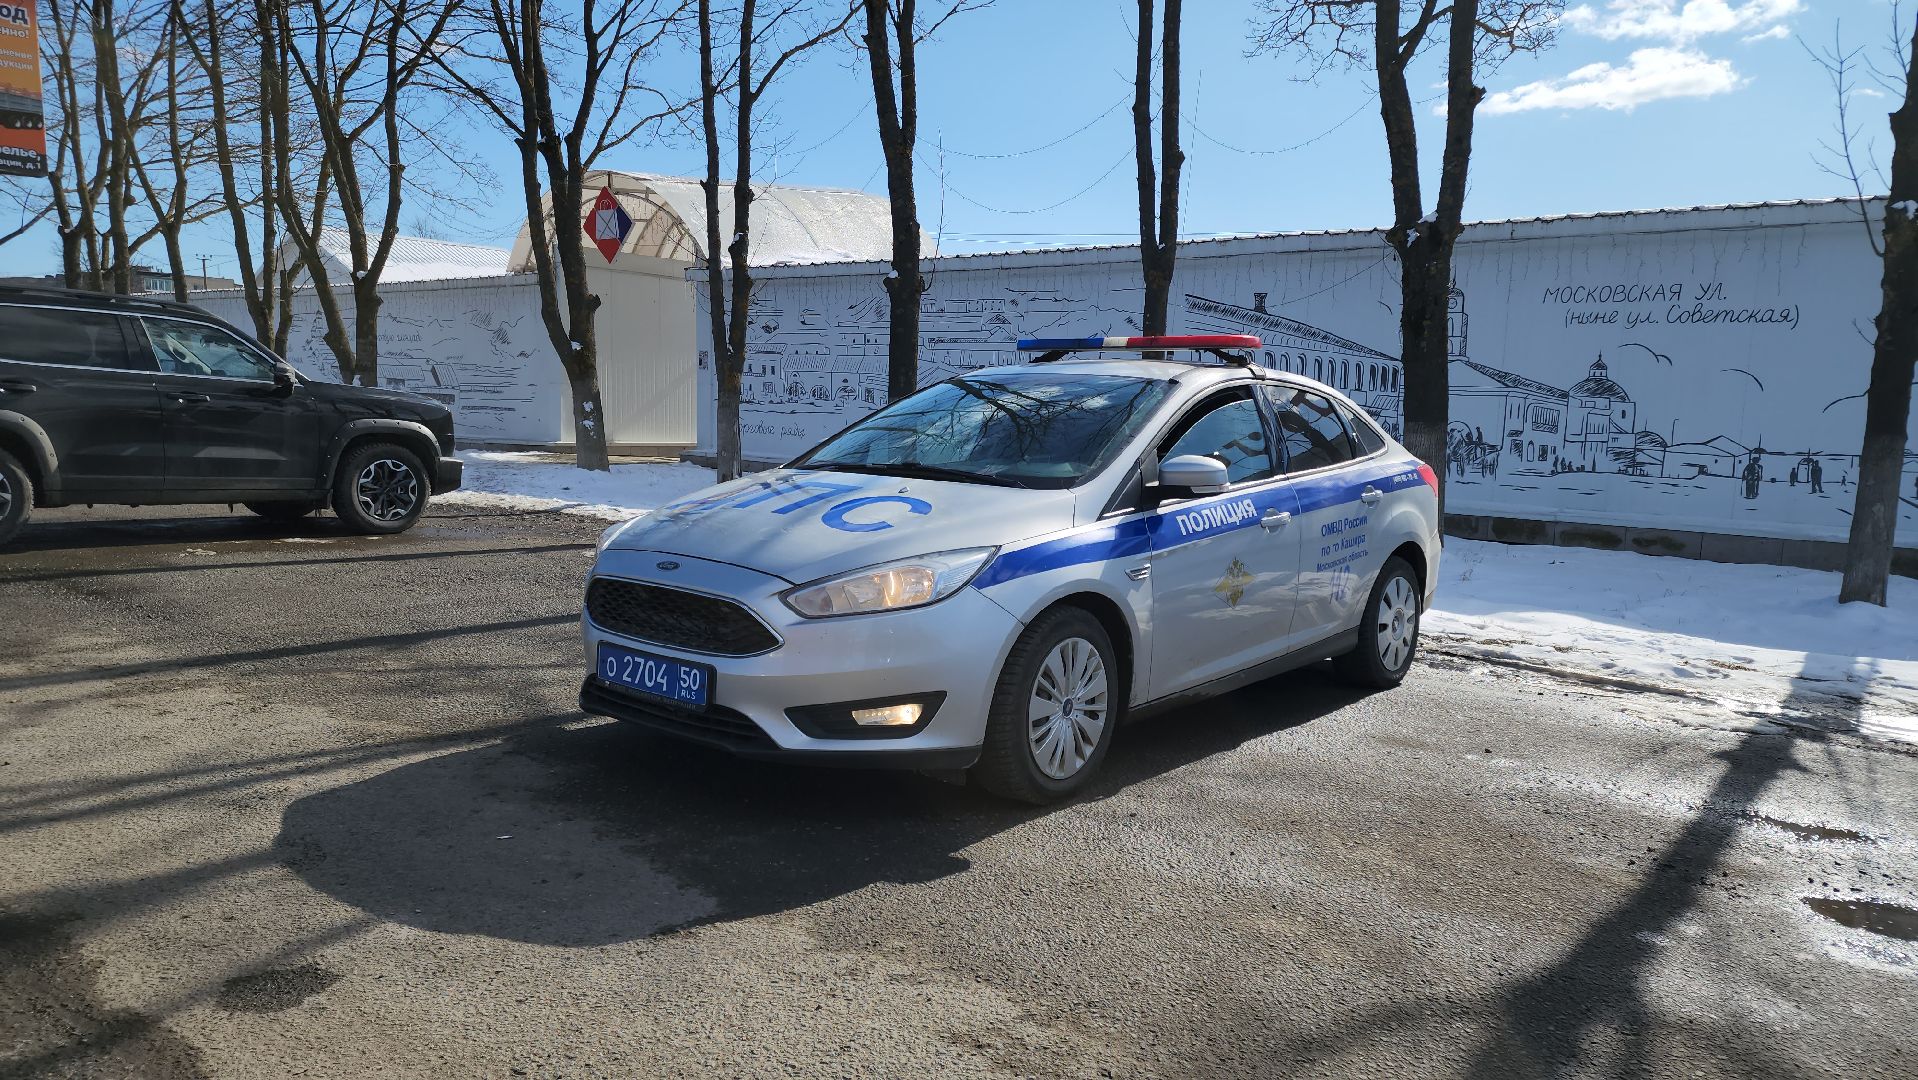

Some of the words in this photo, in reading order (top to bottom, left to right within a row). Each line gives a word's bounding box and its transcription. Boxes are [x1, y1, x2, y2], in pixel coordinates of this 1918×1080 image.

[0, 26, 30, 39] нно!
[0, 146, 41, 161] елье,
[1542, 283, 1683, 304] МОСКОВСКАЯ
[1694, 281, 1727, 301] УЛ.
[1564, 306, 1619, 329] (ныне
[1625, 312, 1660, 330] ул.
[1666, 302, 1800, 331] Советская)
[1176, 499, 1258, 536] ПОЛИЦИЯ
[1321, 519, 1343, 537] ОМВД
[1343, 515, 1368, 530] России
[622, 655, 668, 692] 2704
[680, 666, 700, 691] 50
